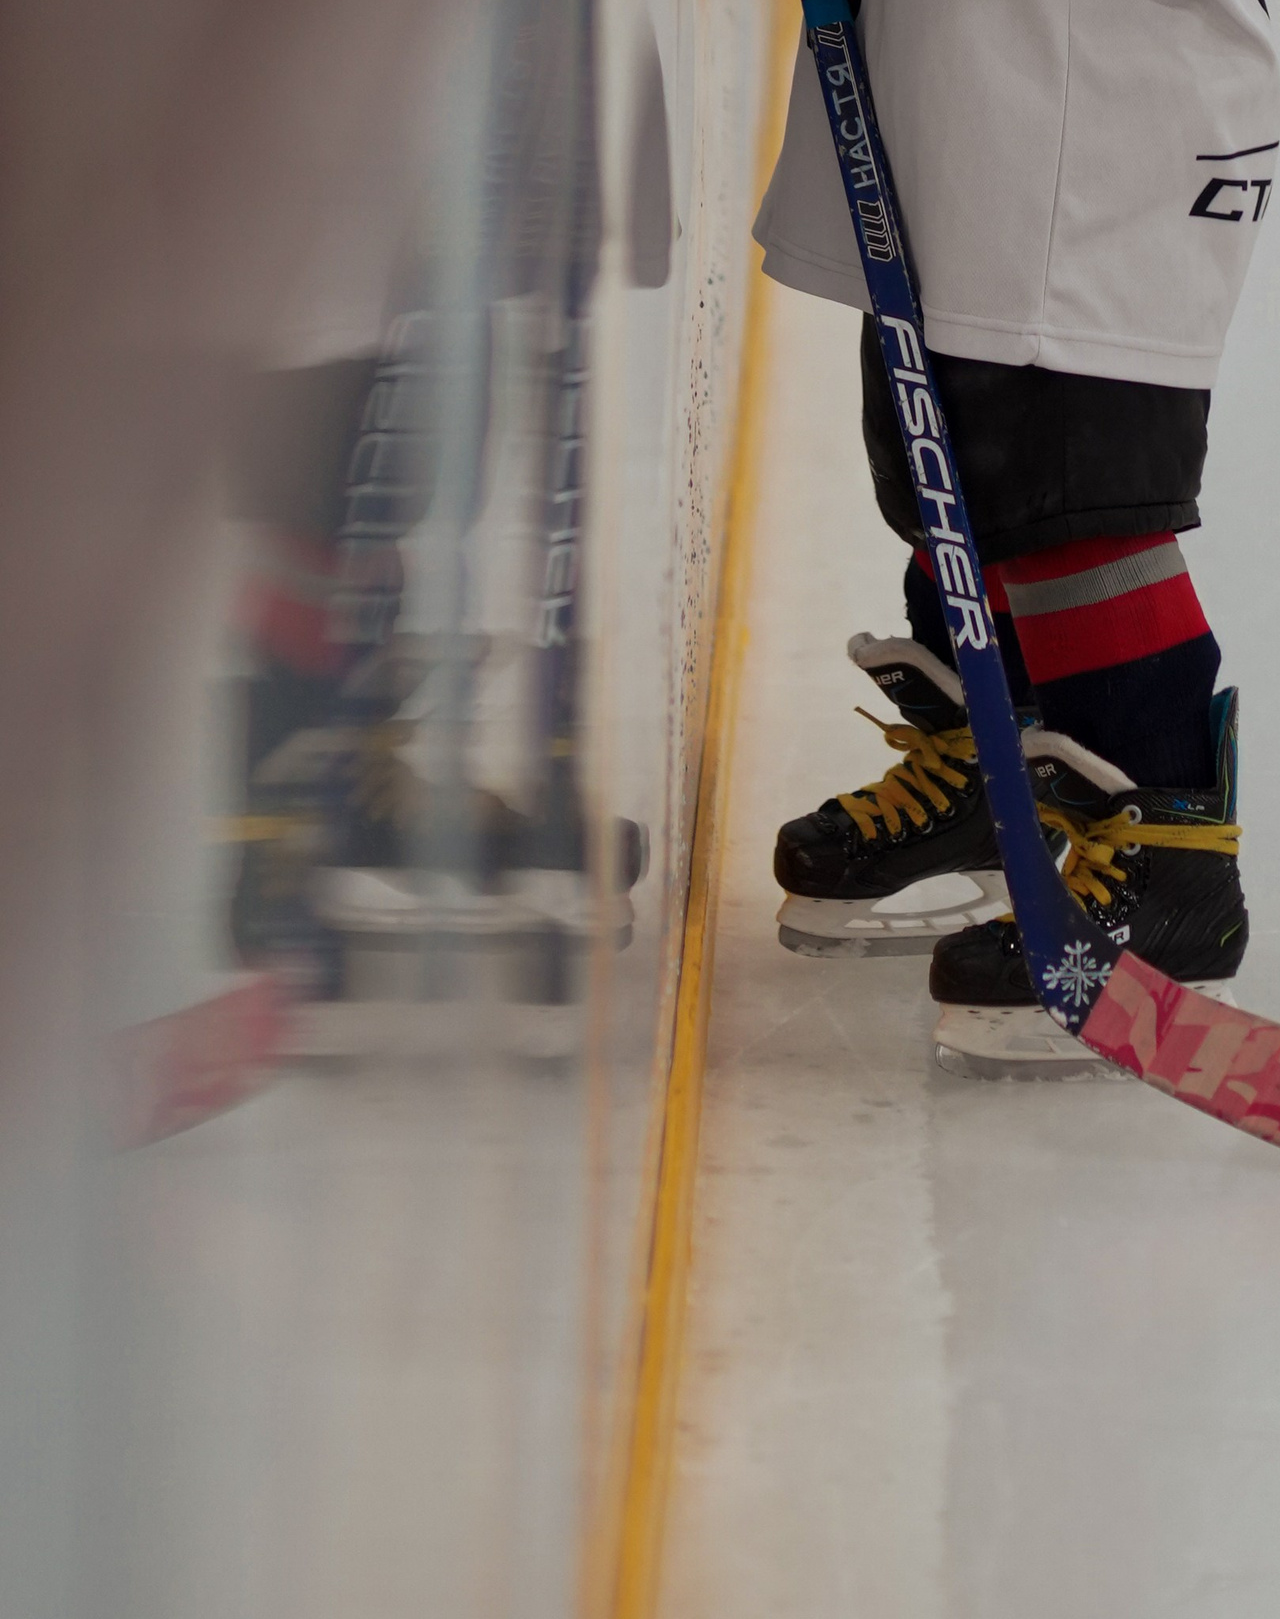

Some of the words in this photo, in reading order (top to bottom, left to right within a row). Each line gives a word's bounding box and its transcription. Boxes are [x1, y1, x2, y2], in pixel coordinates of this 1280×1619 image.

[826, 62, 877, 189] НАСТЯ
[1188, 177, 1272, 222] СТ
[880, 313, 988, 651] FISCHER
